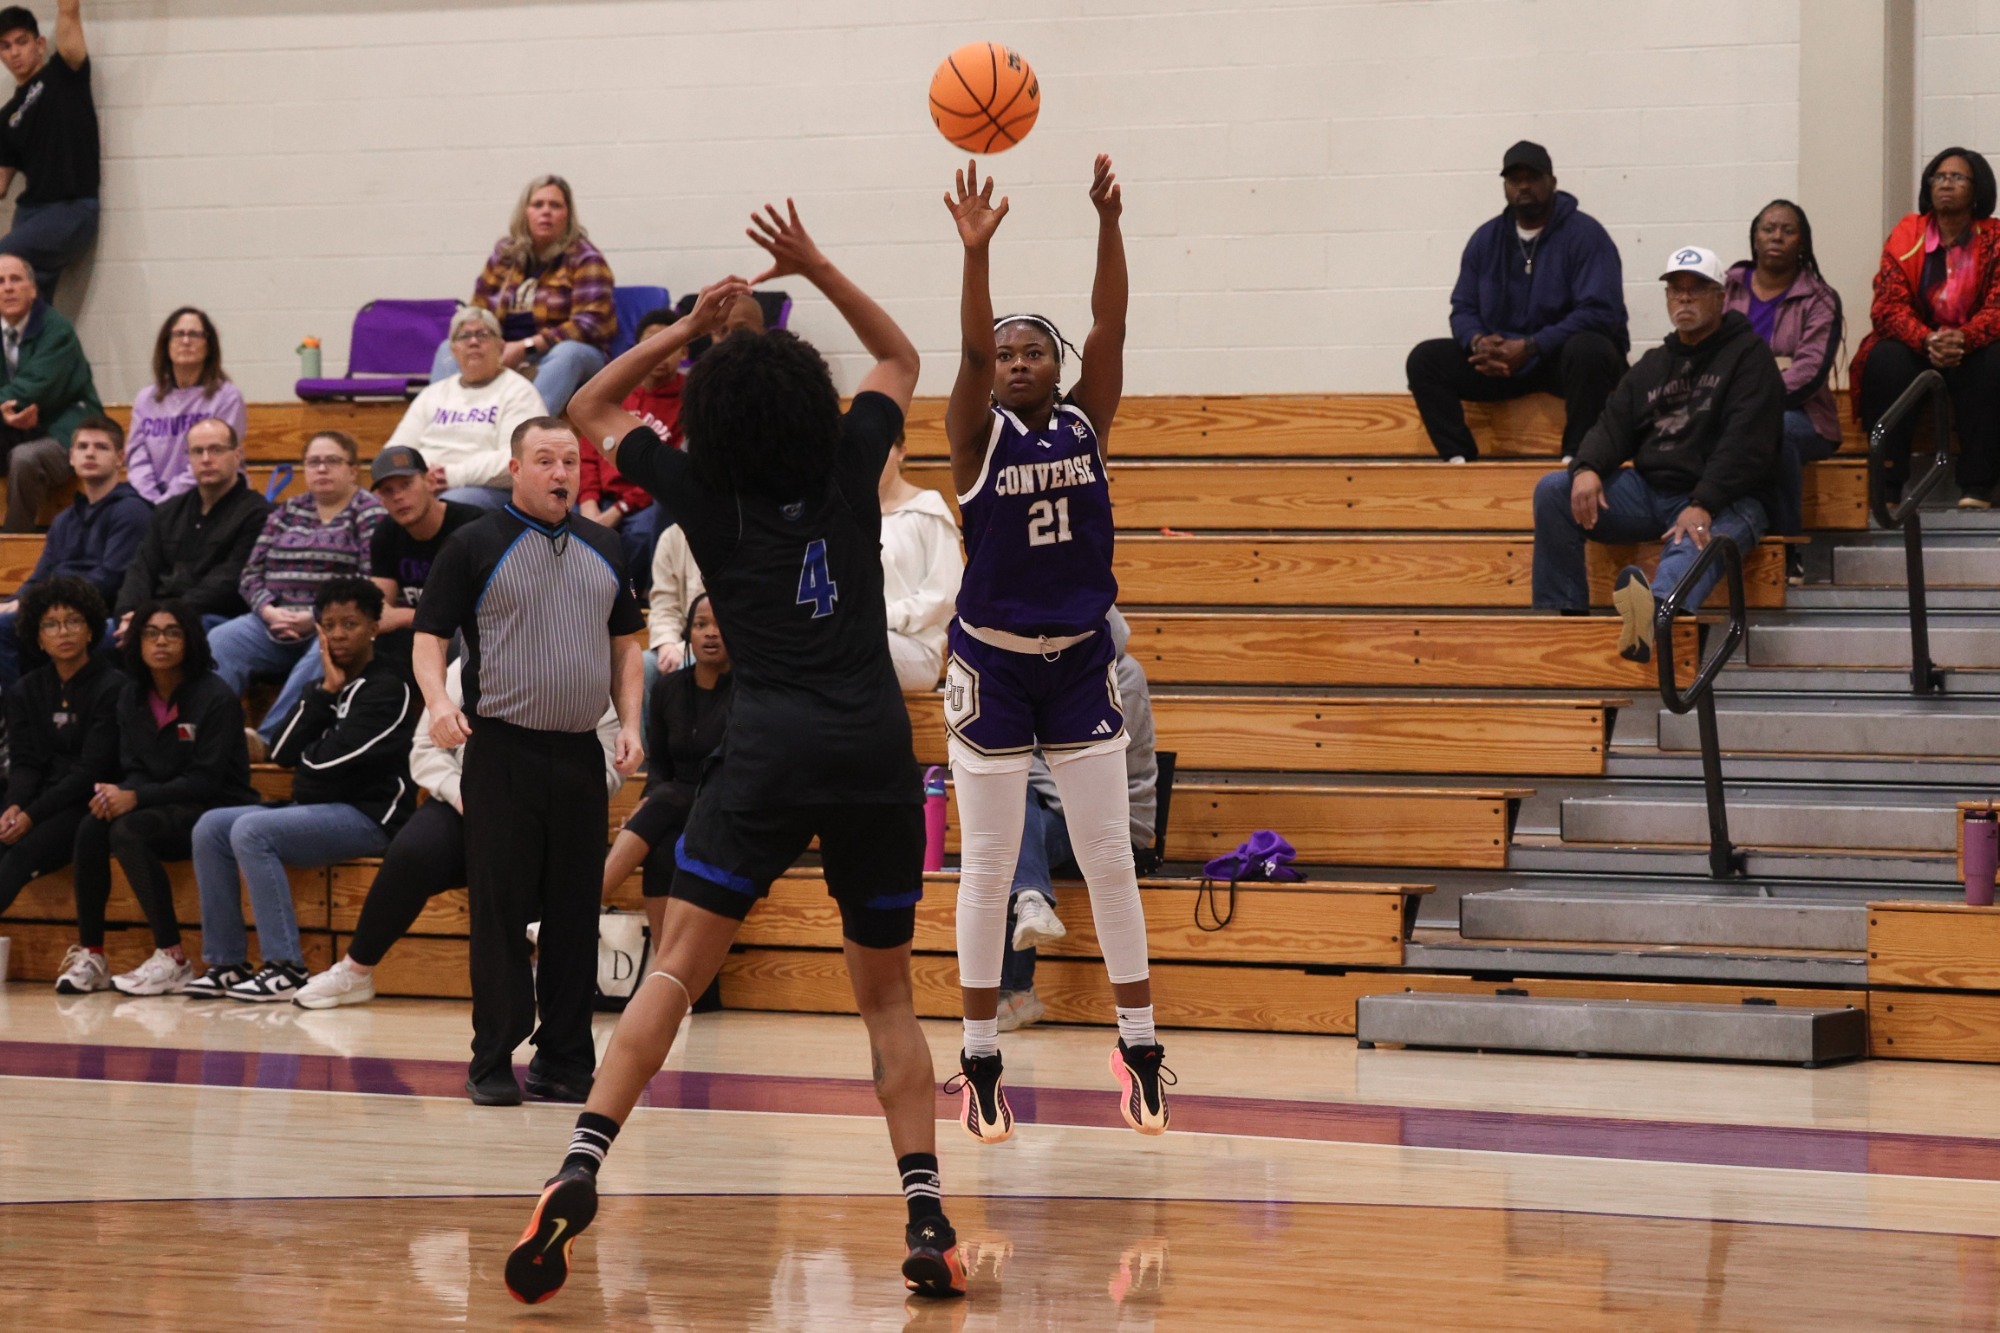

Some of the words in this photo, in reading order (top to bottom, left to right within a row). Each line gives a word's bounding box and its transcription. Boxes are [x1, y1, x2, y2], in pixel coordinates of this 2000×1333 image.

[995, 453, 1096, 496] CONVERSE
[1028, 496, 1073, 547] 21
[796, 538, 838, 619] 4
[612, 950, 633, 980] D
